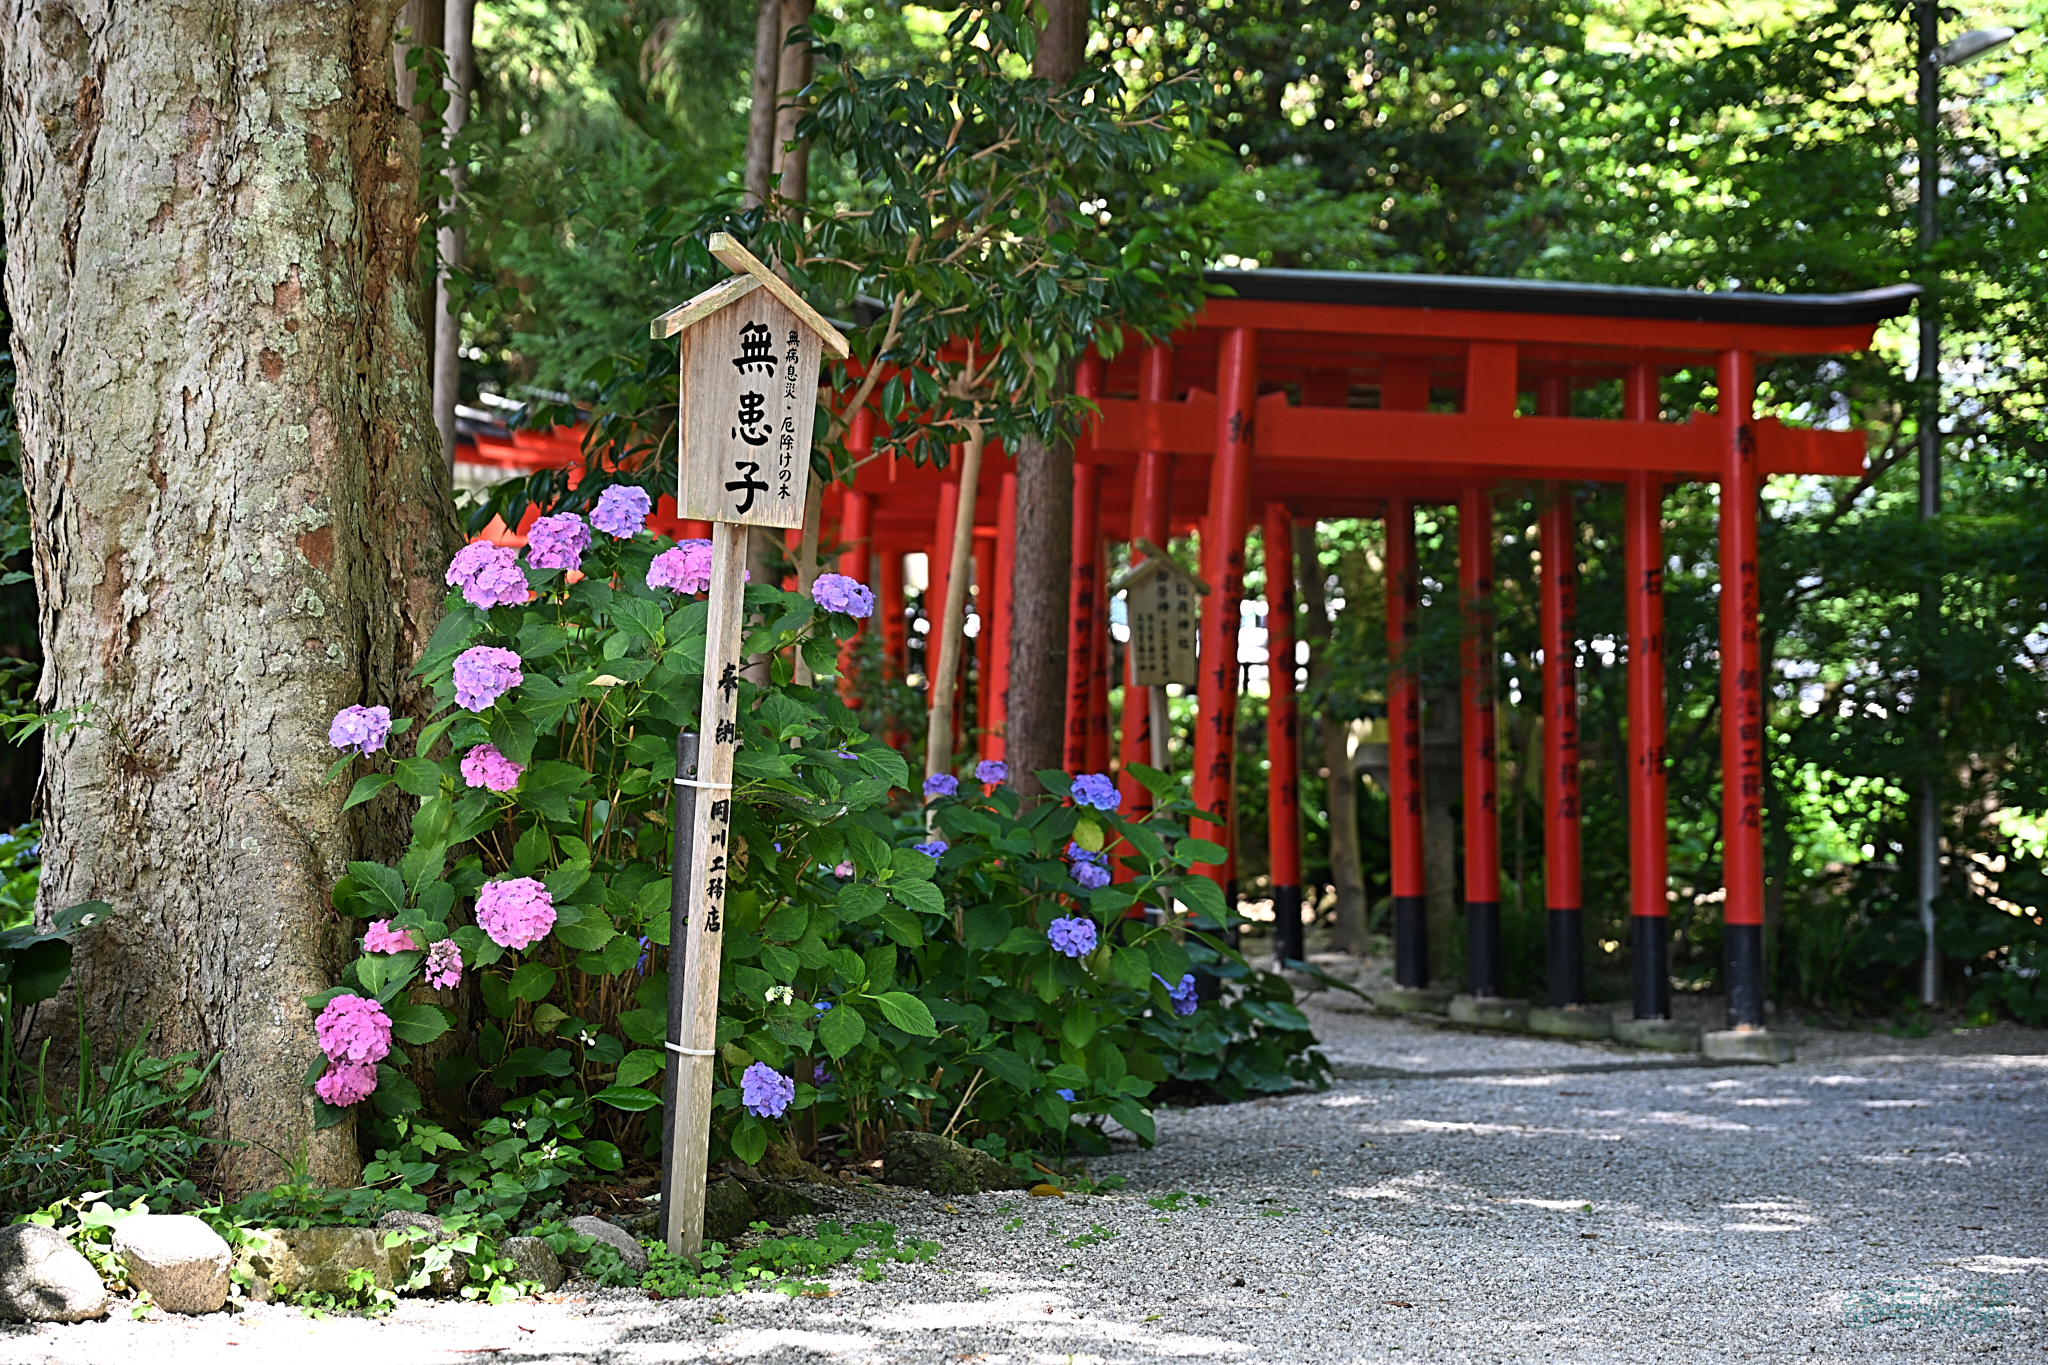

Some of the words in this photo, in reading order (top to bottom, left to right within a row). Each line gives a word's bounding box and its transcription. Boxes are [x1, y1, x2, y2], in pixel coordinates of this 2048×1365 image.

[724, 321, 778, 515] 無患子
[777, 330, 800, 500] 無病息災・厄除けの木
[1732, 424, 1757, 463] 奉
[714, 662, 738, 745] 奉納
[704, 799, 729, 933] 岡川工務店
